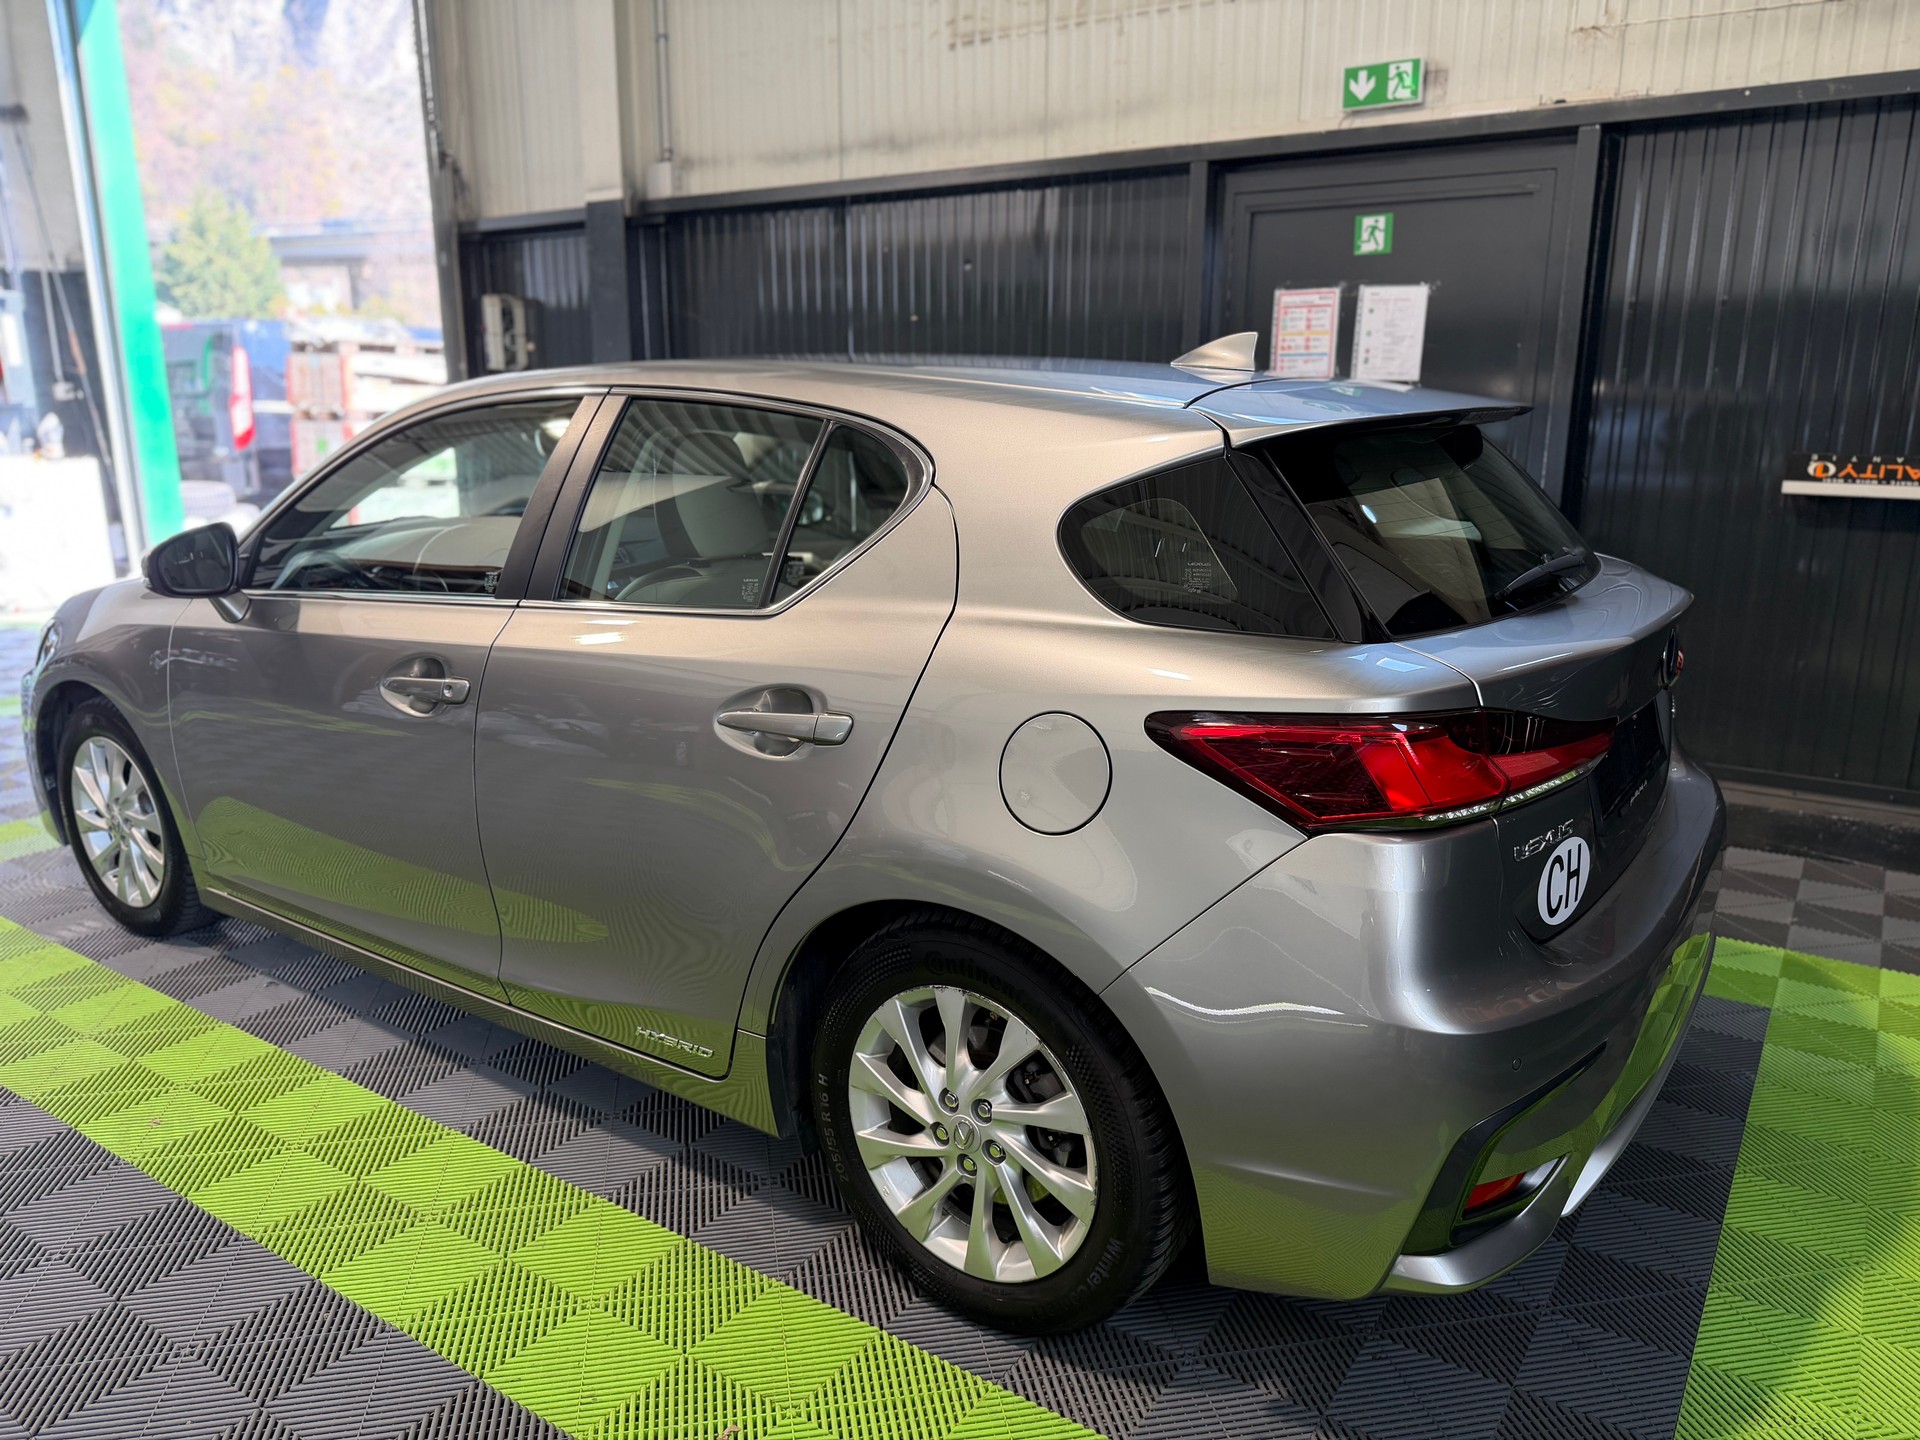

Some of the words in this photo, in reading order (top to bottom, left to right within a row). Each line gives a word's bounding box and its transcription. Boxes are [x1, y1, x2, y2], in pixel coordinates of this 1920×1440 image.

[1513, 818, 1574, 862] LEXUS
[1546, 842, 1582, 919] CH
[635, 1026, 715, 1058] HYBRID
